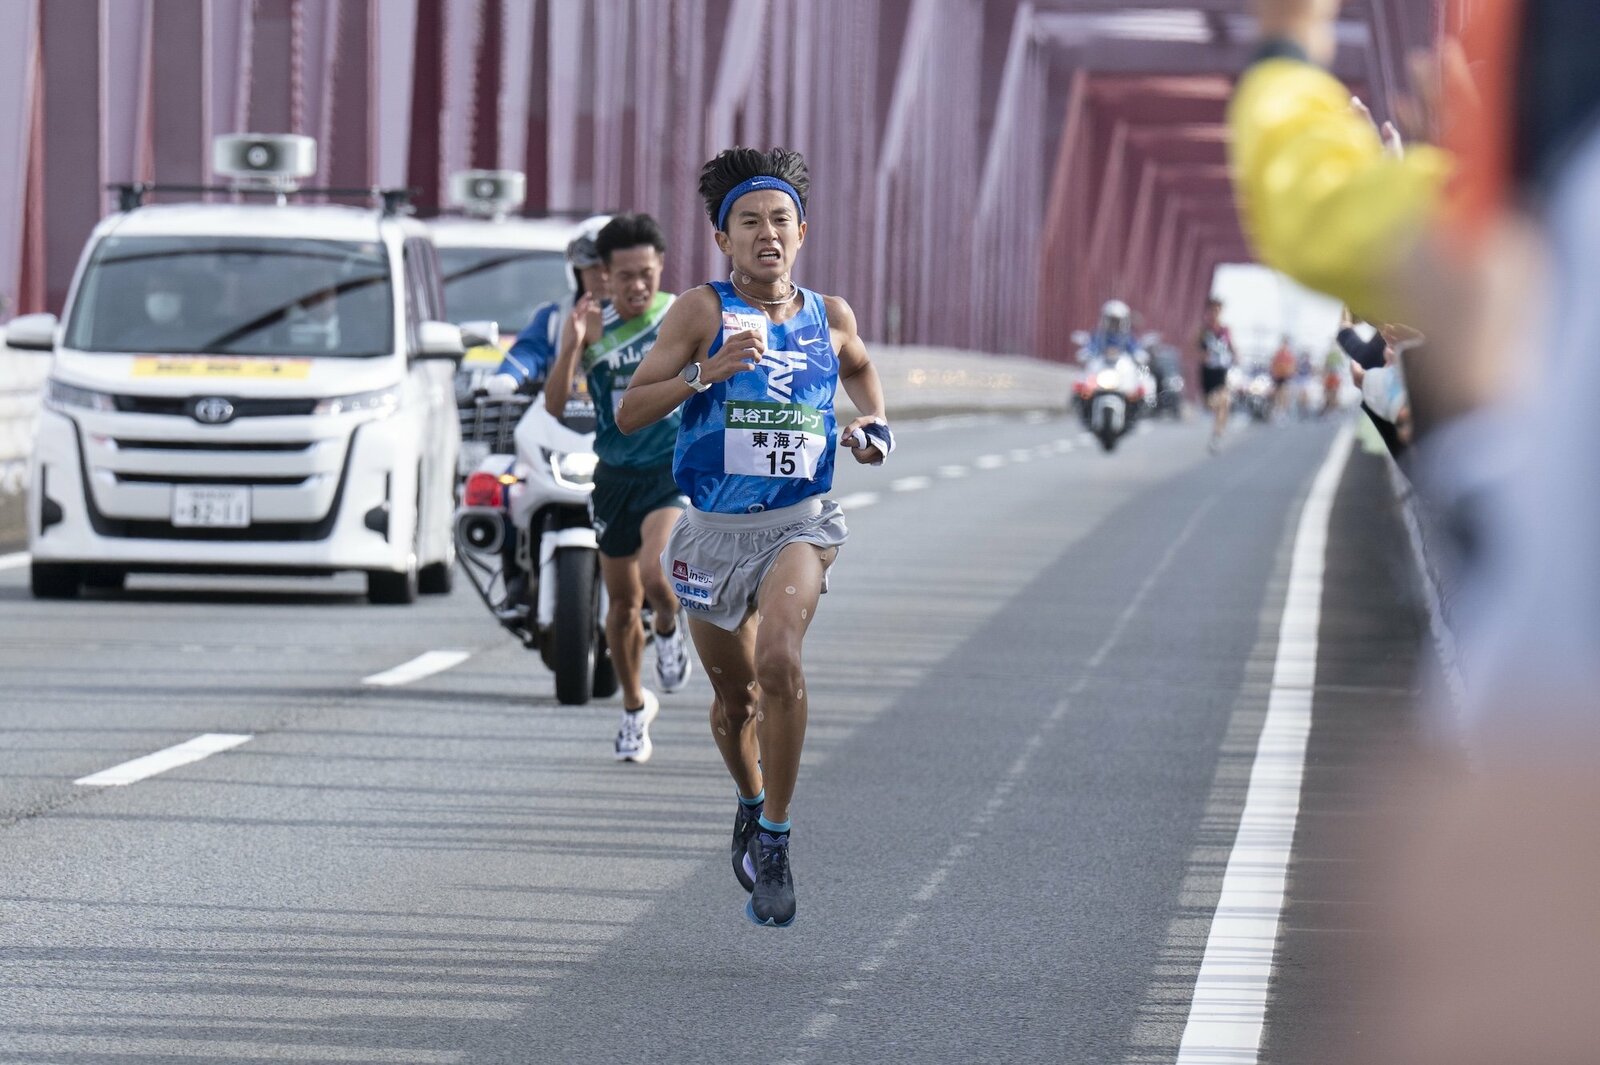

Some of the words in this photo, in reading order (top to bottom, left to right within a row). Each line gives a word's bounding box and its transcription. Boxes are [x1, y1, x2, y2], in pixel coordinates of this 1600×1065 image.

[752, 431, 809, 449] 東海大
[766, 450, 796, 475] 15
[675, 583, 709, 599] OILES
[674, 593, 710, 612] OKAI
